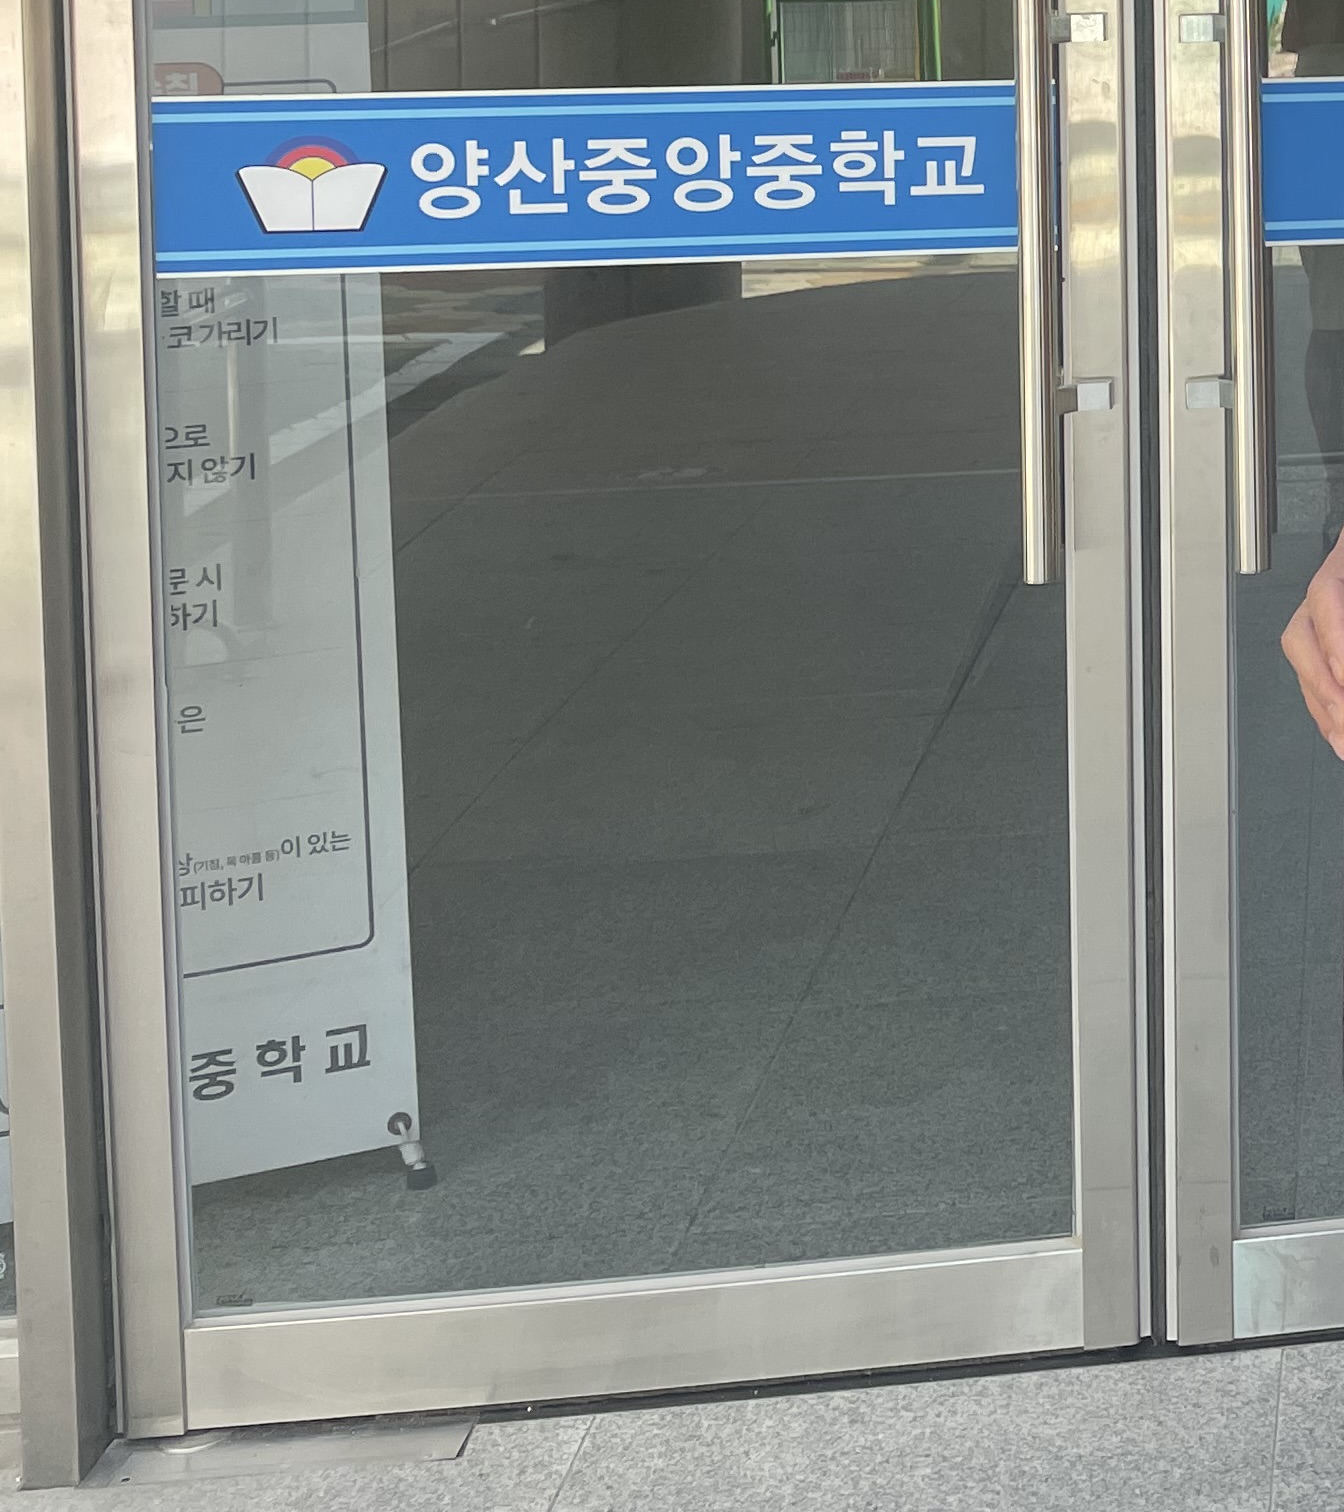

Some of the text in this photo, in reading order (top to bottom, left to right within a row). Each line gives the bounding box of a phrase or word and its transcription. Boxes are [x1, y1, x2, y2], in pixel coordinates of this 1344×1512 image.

[410, 129, 986, 220] 양산중앙중학교
[188, 287, 216, 315] 때
[200, 452, 255, 484] 않기
[196, 563, 222, 592] 시
[307, 830, 352, 856] 있는
[180, 872, 264, 911] 피하기
